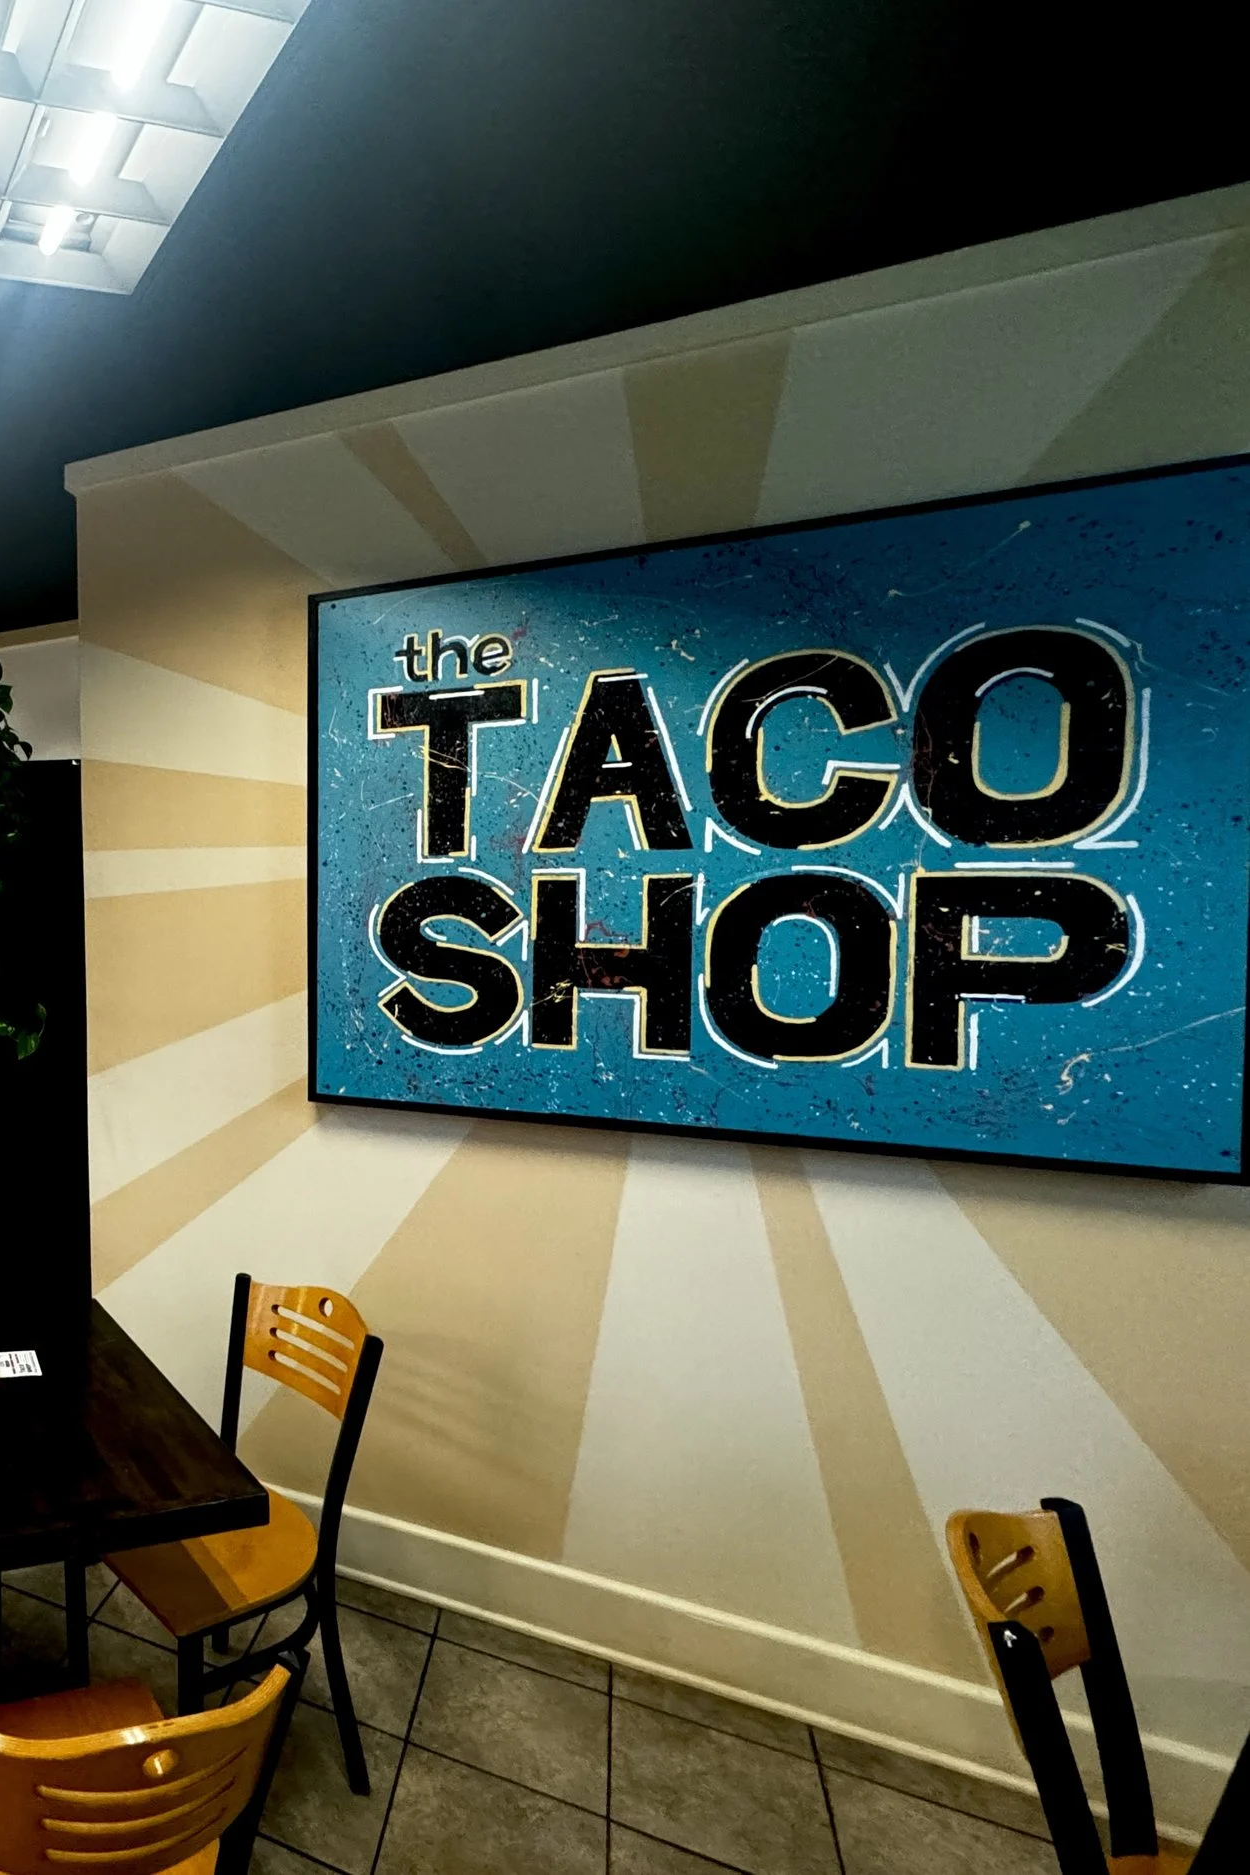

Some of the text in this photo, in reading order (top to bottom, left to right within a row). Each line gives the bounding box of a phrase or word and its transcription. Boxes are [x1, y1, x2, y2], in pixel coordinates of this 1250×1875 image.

[369, 622, 1148, 862] TACO
[393, 629, 512, 682] the
[369, 862, 1145, 1070] SHOP
